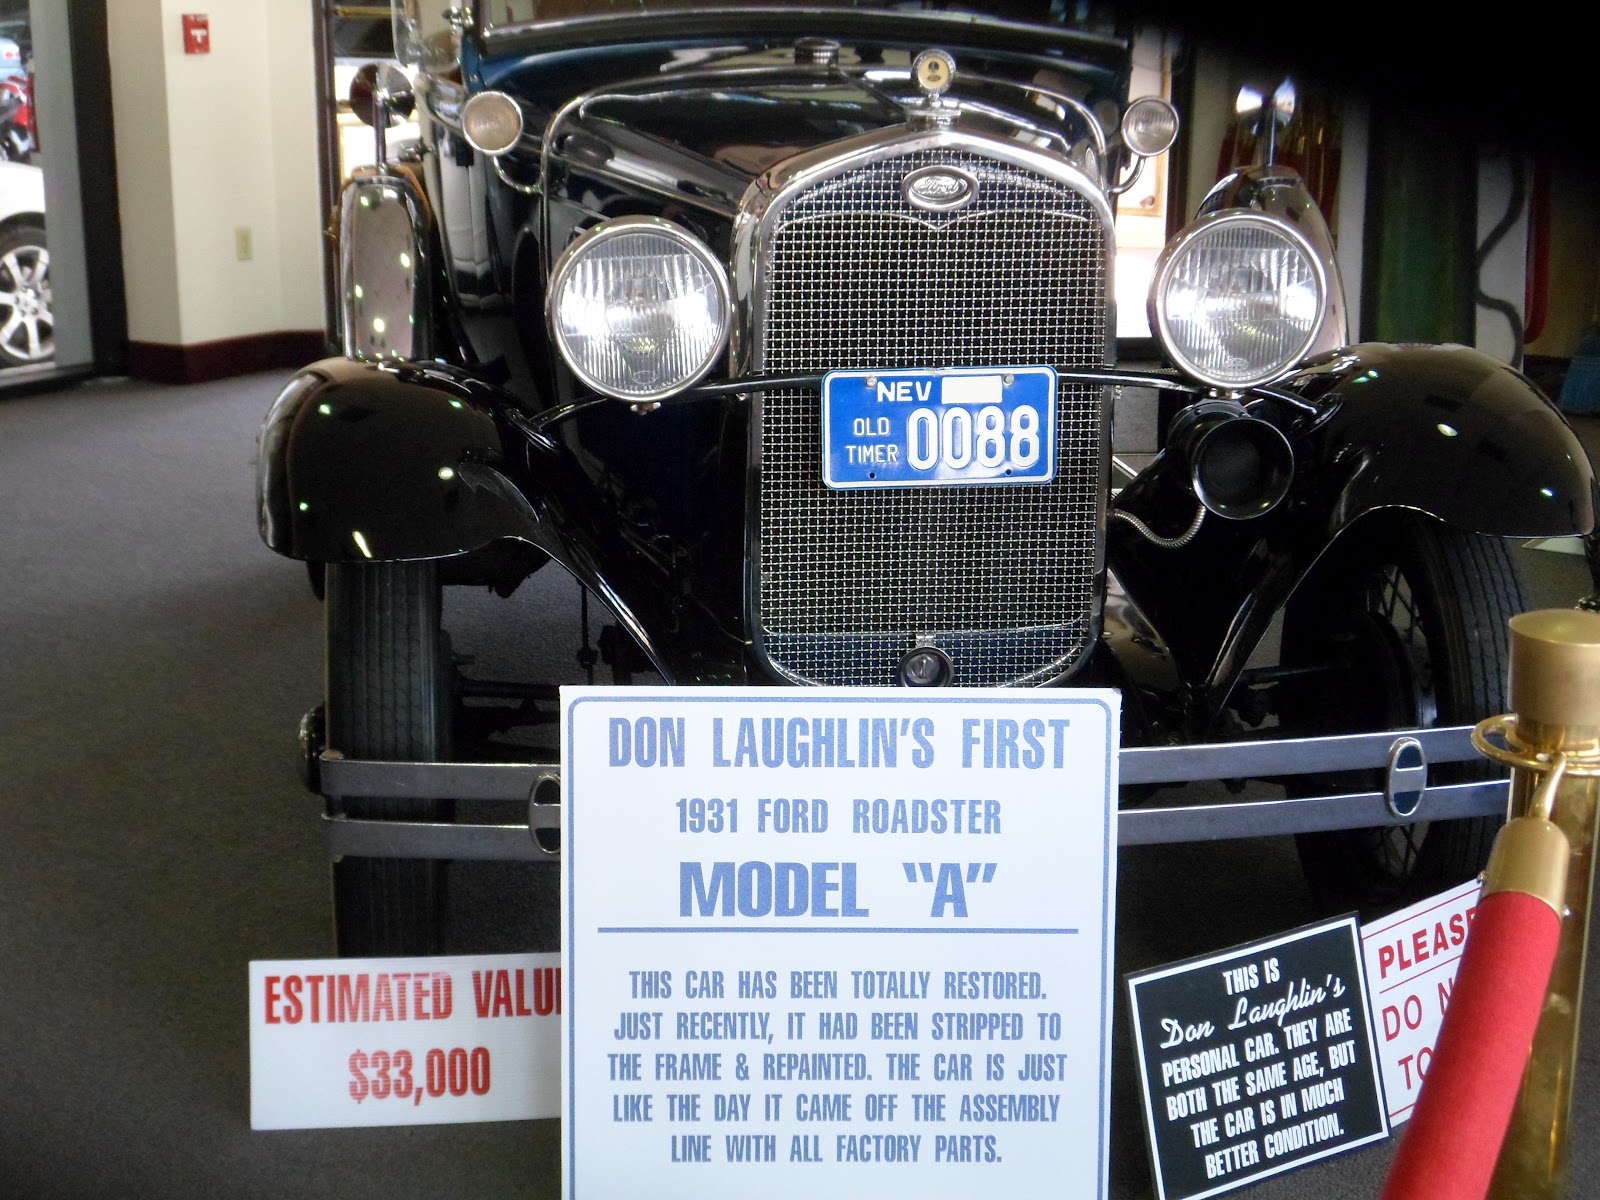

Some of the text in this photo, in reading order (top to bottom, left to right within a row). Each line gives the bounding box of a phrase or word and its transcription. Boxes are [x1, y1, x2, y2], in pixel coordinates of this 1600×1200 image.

[877, 380, 932, 403] NEV
[853, 416, 890, 437] OLD
[908, 404, 1040, 471] 0088
[845, 444, 898, 464] TIMER
[609, 716, 1070, 770] DON LAUGHLIN'S FIRST
[675, 797, 1002, 835] 1931 FORD ROADSTER
[679, 860, 870, 918] MODEL
[264, 971, 453, 1025] ESTIMATED
[628, 969, 1047, 1000] THIS CAR HAS BEEN TOTALLY RESTORED.
[1222, 957, 1280, 996] THIS IS
[613, 1011, 1062, 1045] JUST RECENTLY, IT HAD BEEN STRIPPED TO
[1160, 973, 1346, 1049] Don Laughlin's
[1381, 994, 1422, 1042] DO
[607, 1052, 1068, 1082] THE FRAME & REPAINTED. THE CAR IS JUST
[1161, 1007, 1353, 1088] PERSONAL CAR. THEY ARE
[348, 1046, 491, 1105] $33,000
[1166, 1040, 1356, 1122] BOTH THE SAME AGE, BUT
[612, 1093, 1061, 1123] LIKE THE DAY IT CAME OFF THE ASSEMBLY
[1190, 1077, 1345, 1148] THE CAR IS IN MUCH
[670, 1134, 1003, 1164] LINE WITH ALL FACTORY PARTS.
[1204, 1112, 1345, 1180] BETTER CONDITION.
